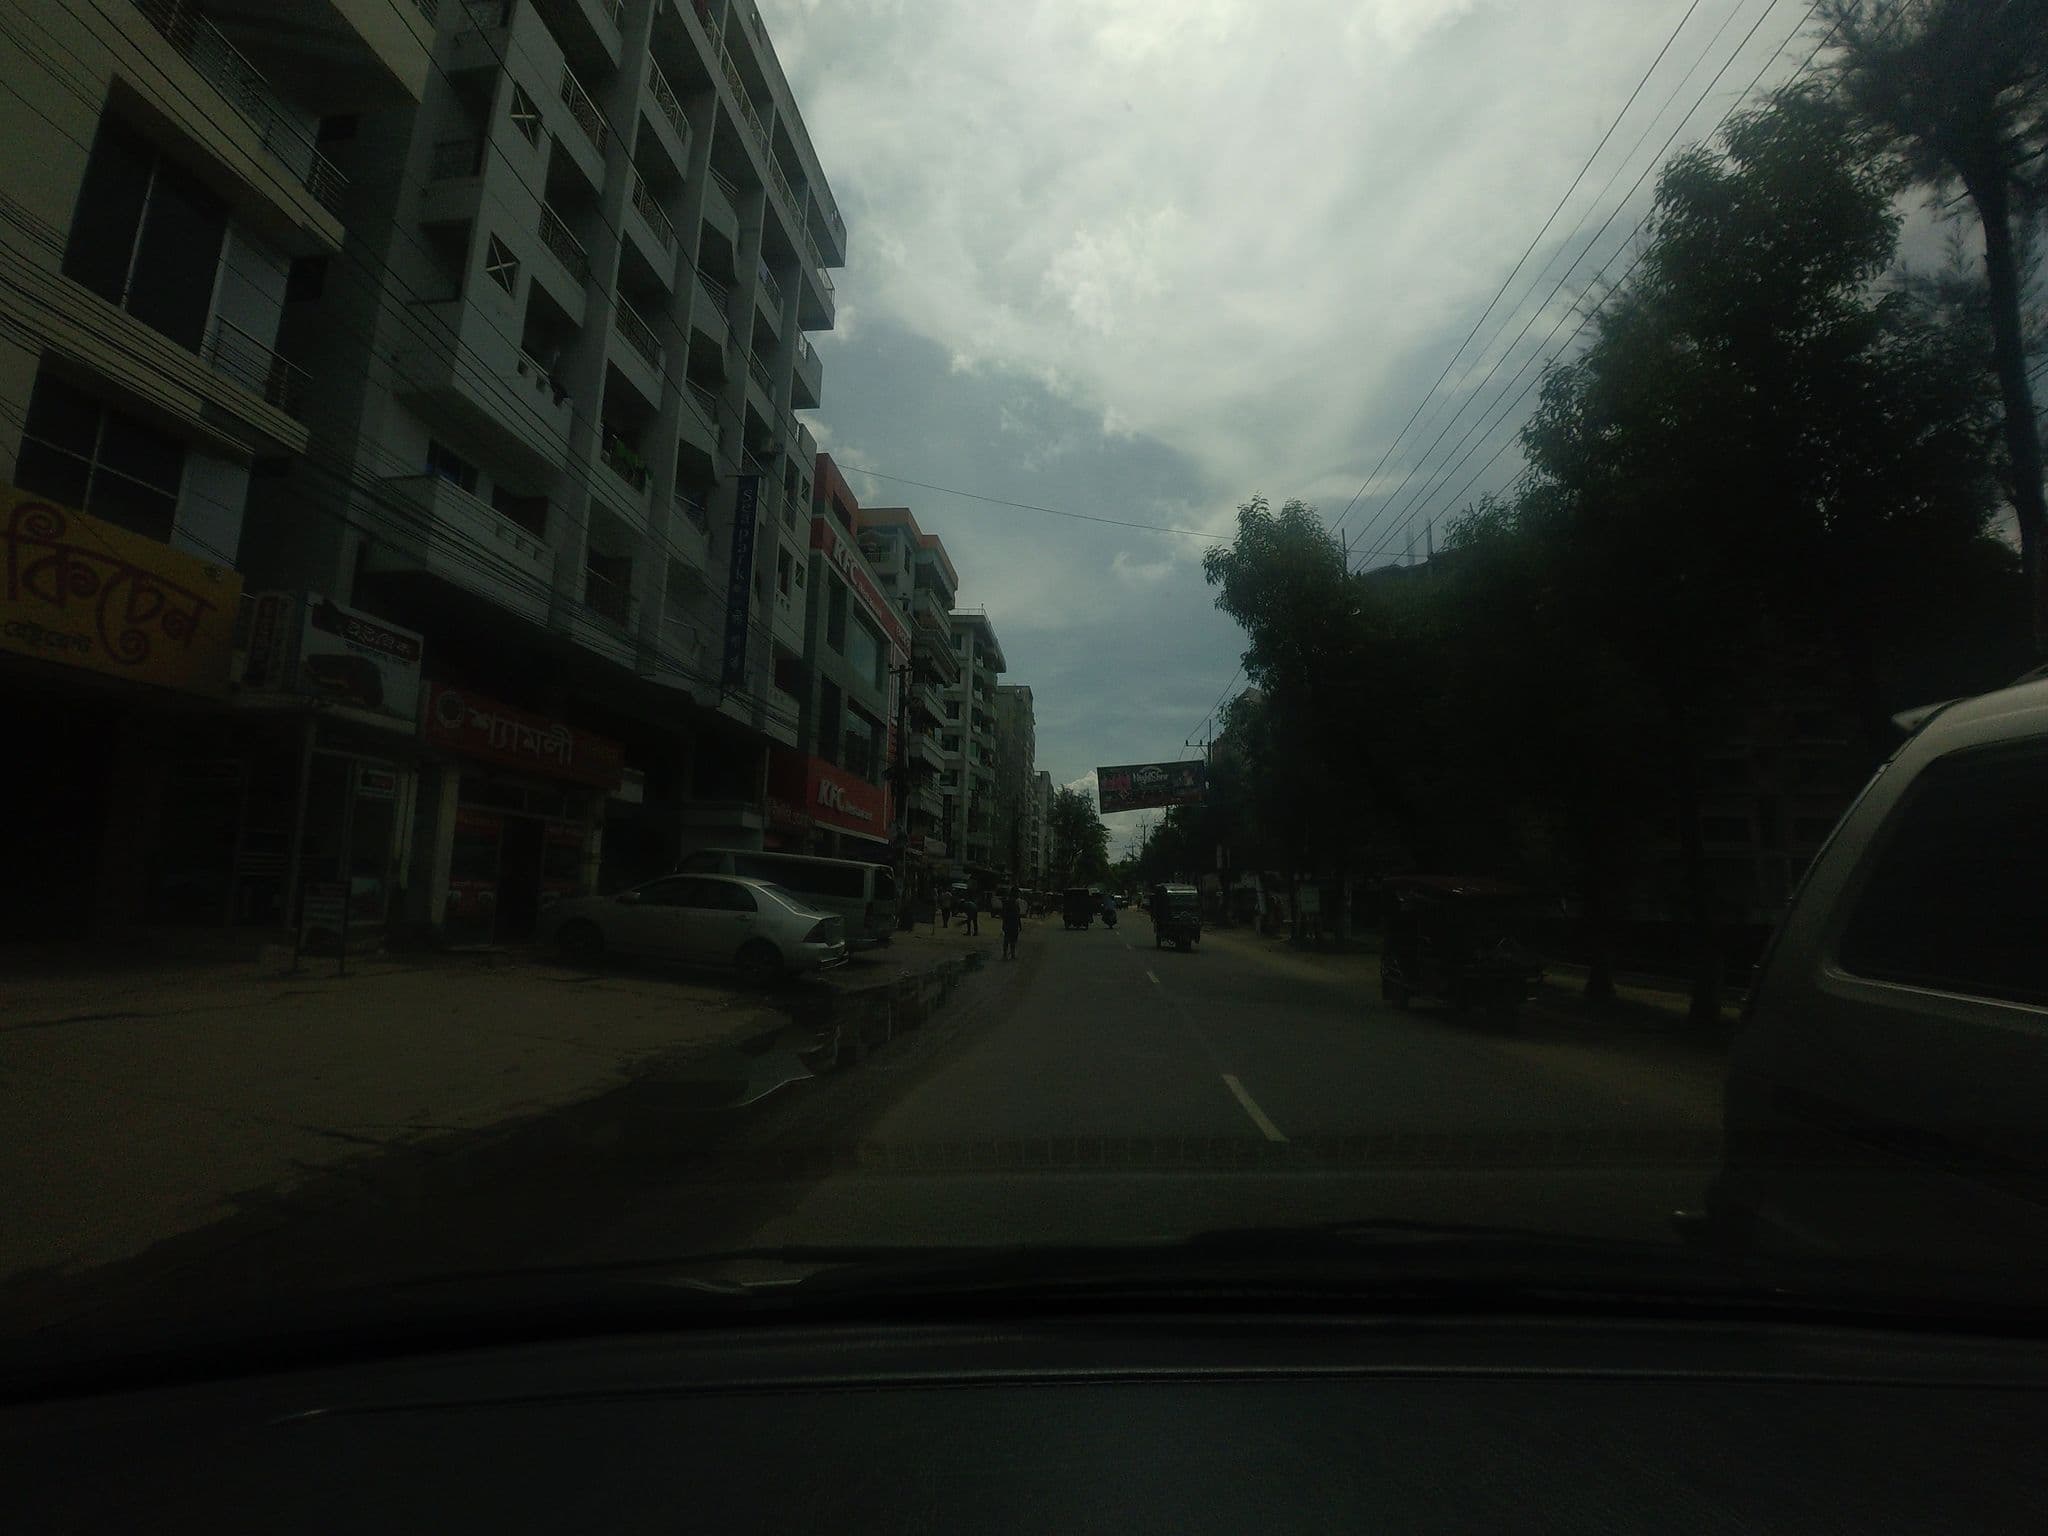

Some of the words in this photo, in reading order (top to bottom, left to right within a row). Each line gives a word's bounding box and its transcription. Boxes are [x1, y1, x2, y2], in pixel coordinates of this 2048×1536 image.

[832, 537, 859, 585] KFC
[464, 706, 577, 769] শ্যামলী
[816, 777, 847, 812] KFC
